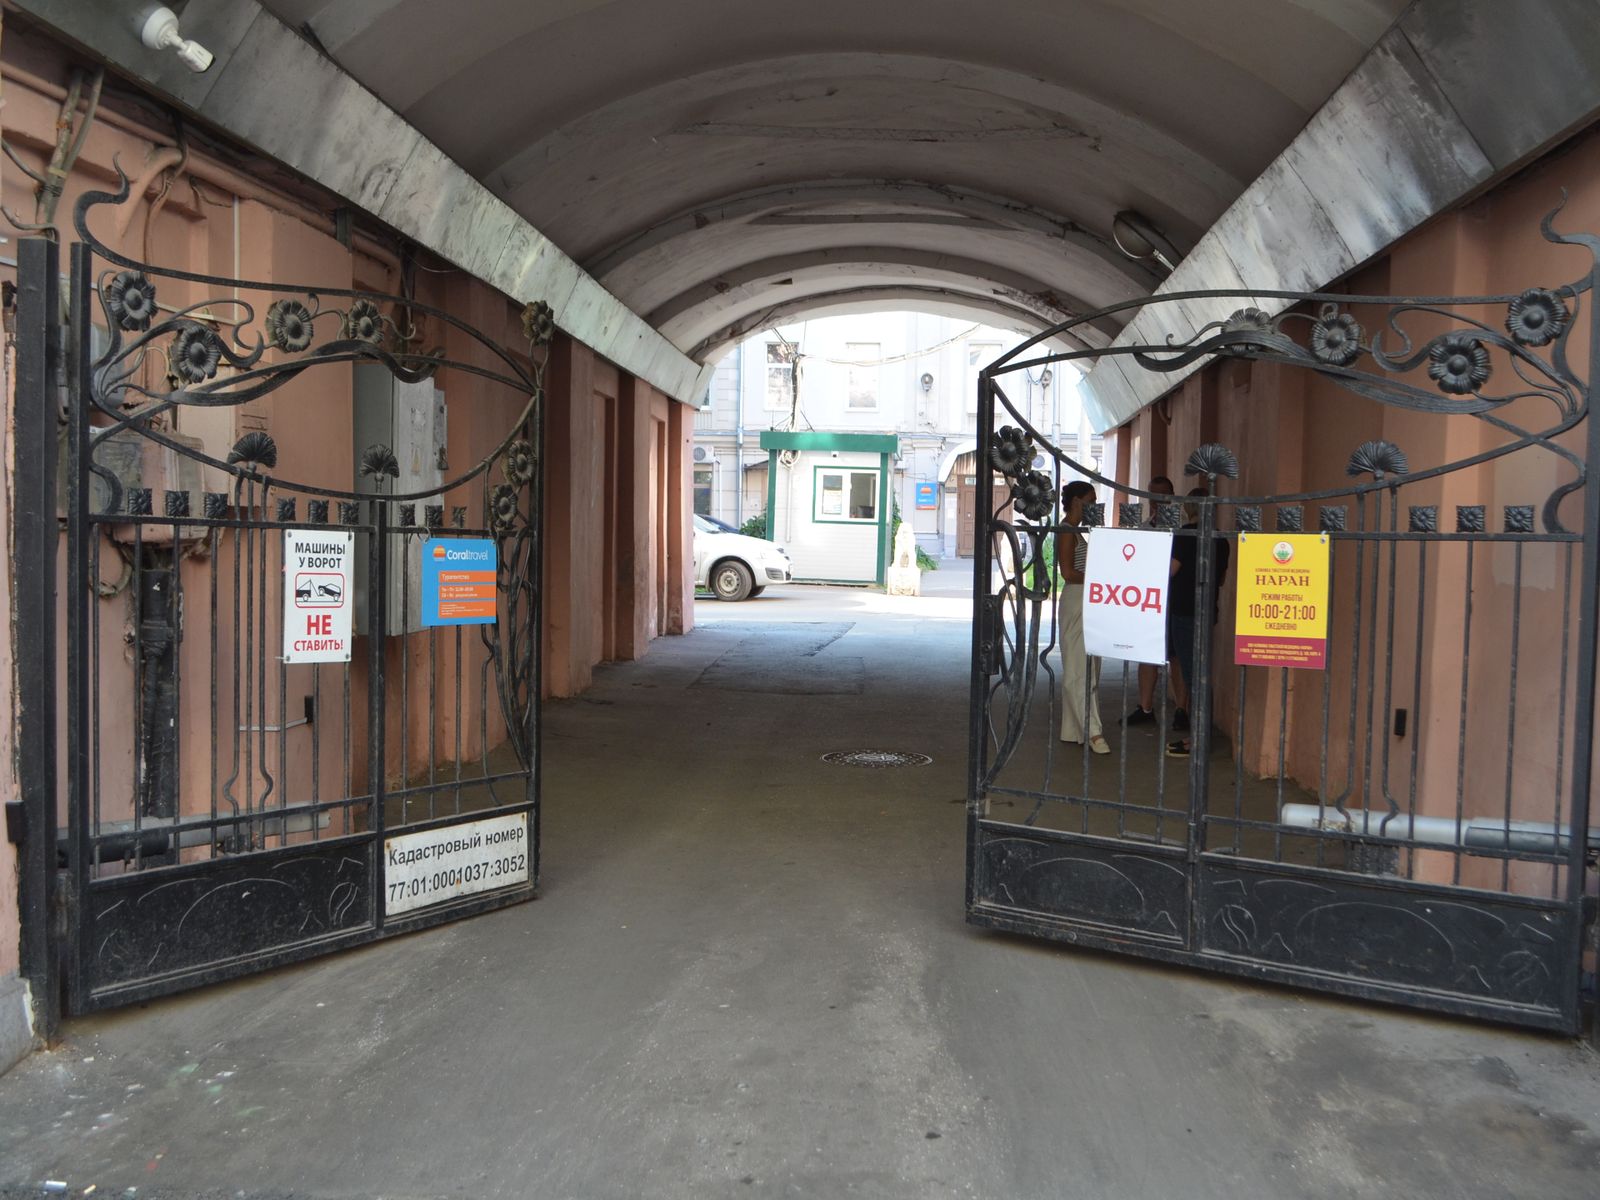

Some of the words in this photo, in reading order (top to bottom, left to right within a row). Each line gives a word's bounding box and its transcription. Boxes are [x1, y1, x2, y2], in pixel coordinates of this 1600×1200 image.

[295, 542, 345, 555] МАШИНЫ
[299, 557, 306, 568] У
[308, 557, 342, 568] ВОРОТ
[1256, 575, 1310, 586] НАРАН
[1089, 582, 1162, 613] ВХОД
[1282, 593, 1303, 602] РАБОТЫ
[1249, 603, 1316, 620] 10:00-21:00
[306, 614, 332, 635] НЕ
[1265, 622, 1297, 630] ЕЖЕДНЕВНО
[294, 639, 343, 651] СТАВИТЬ!
[389, 832, 481, 866] Кадастровый
[485, 826, 524, 845] номер
[389, 854, 525, 902] 77:01:0001037:3052
